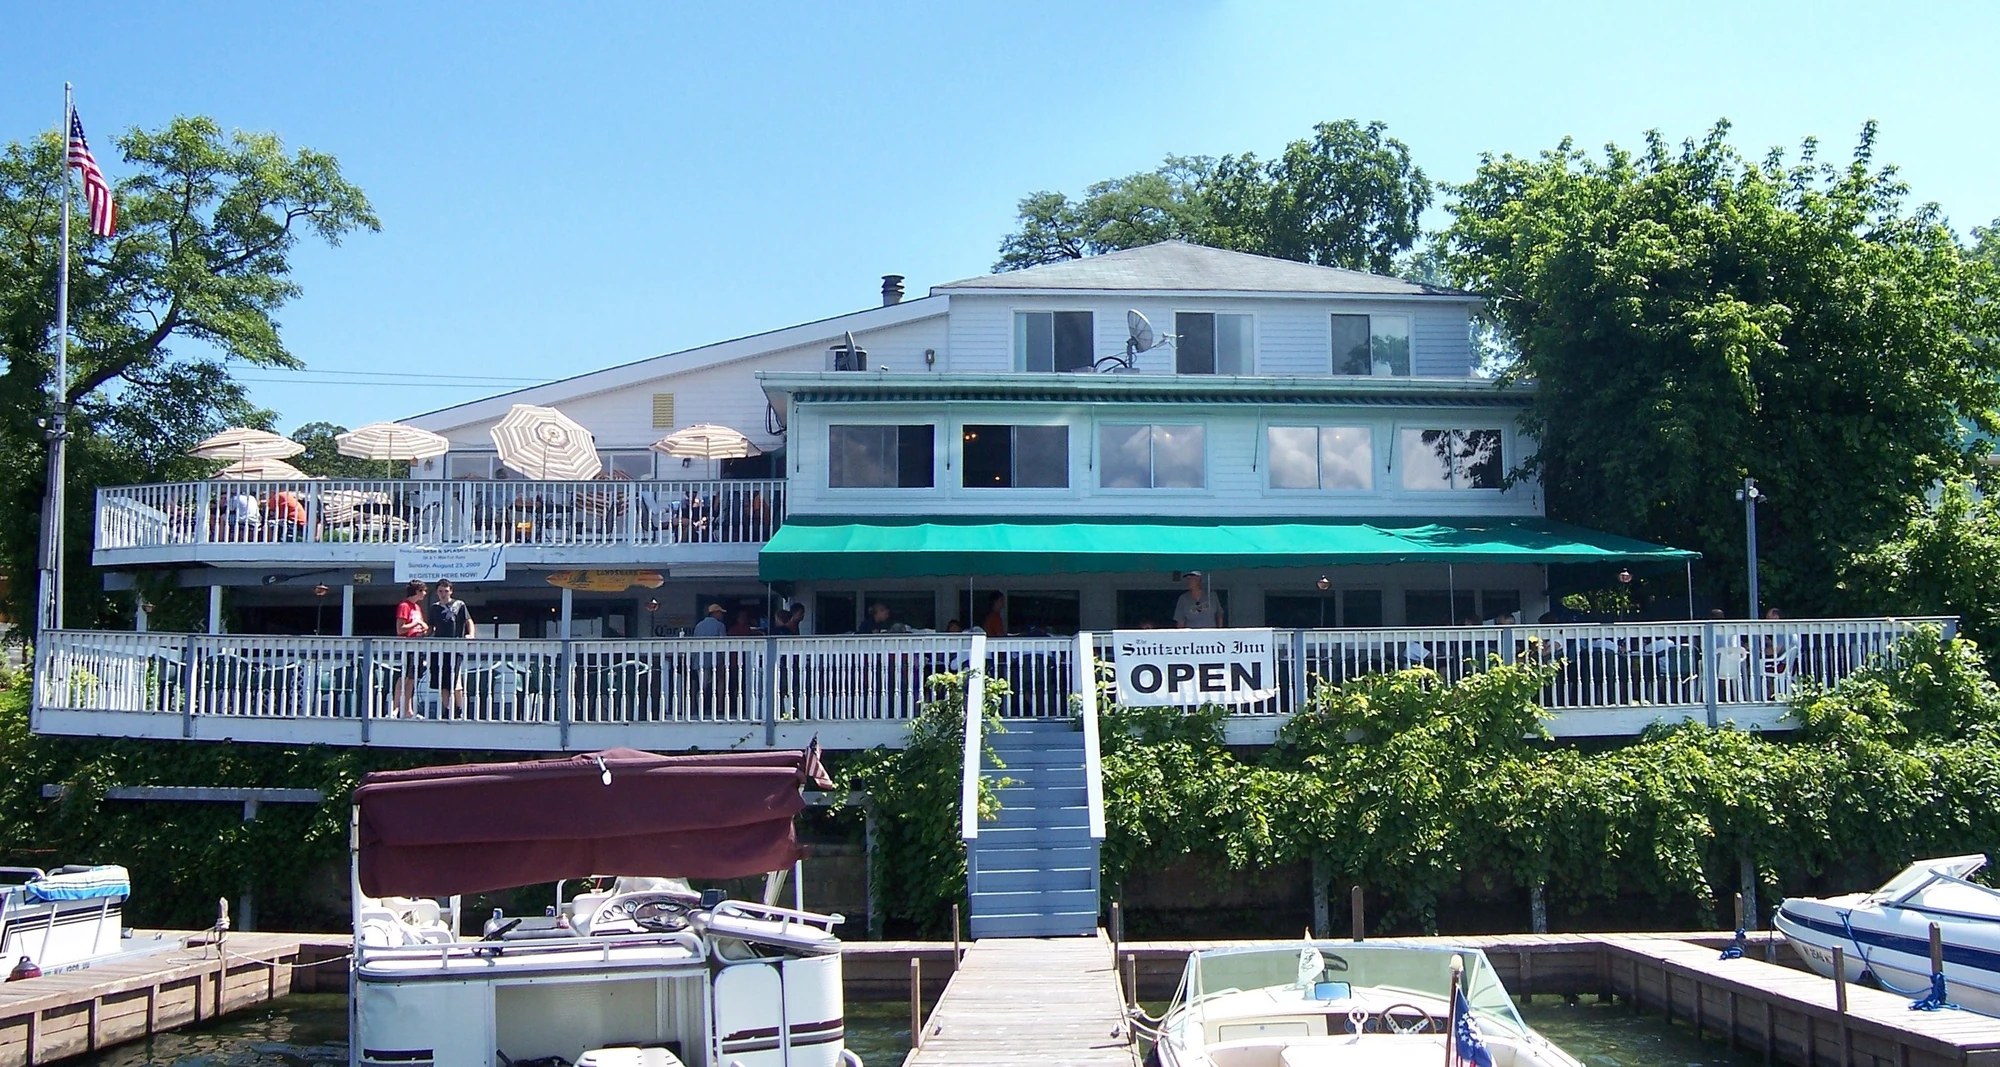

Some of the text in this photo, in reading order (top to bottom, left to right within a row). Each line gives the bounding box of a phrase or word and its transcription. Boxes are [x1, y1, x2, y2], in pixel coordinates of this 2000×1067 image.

[1121, 640, 1265, 657] Switzerland Inn
[1130, 661, 1262, 694] OPEN
